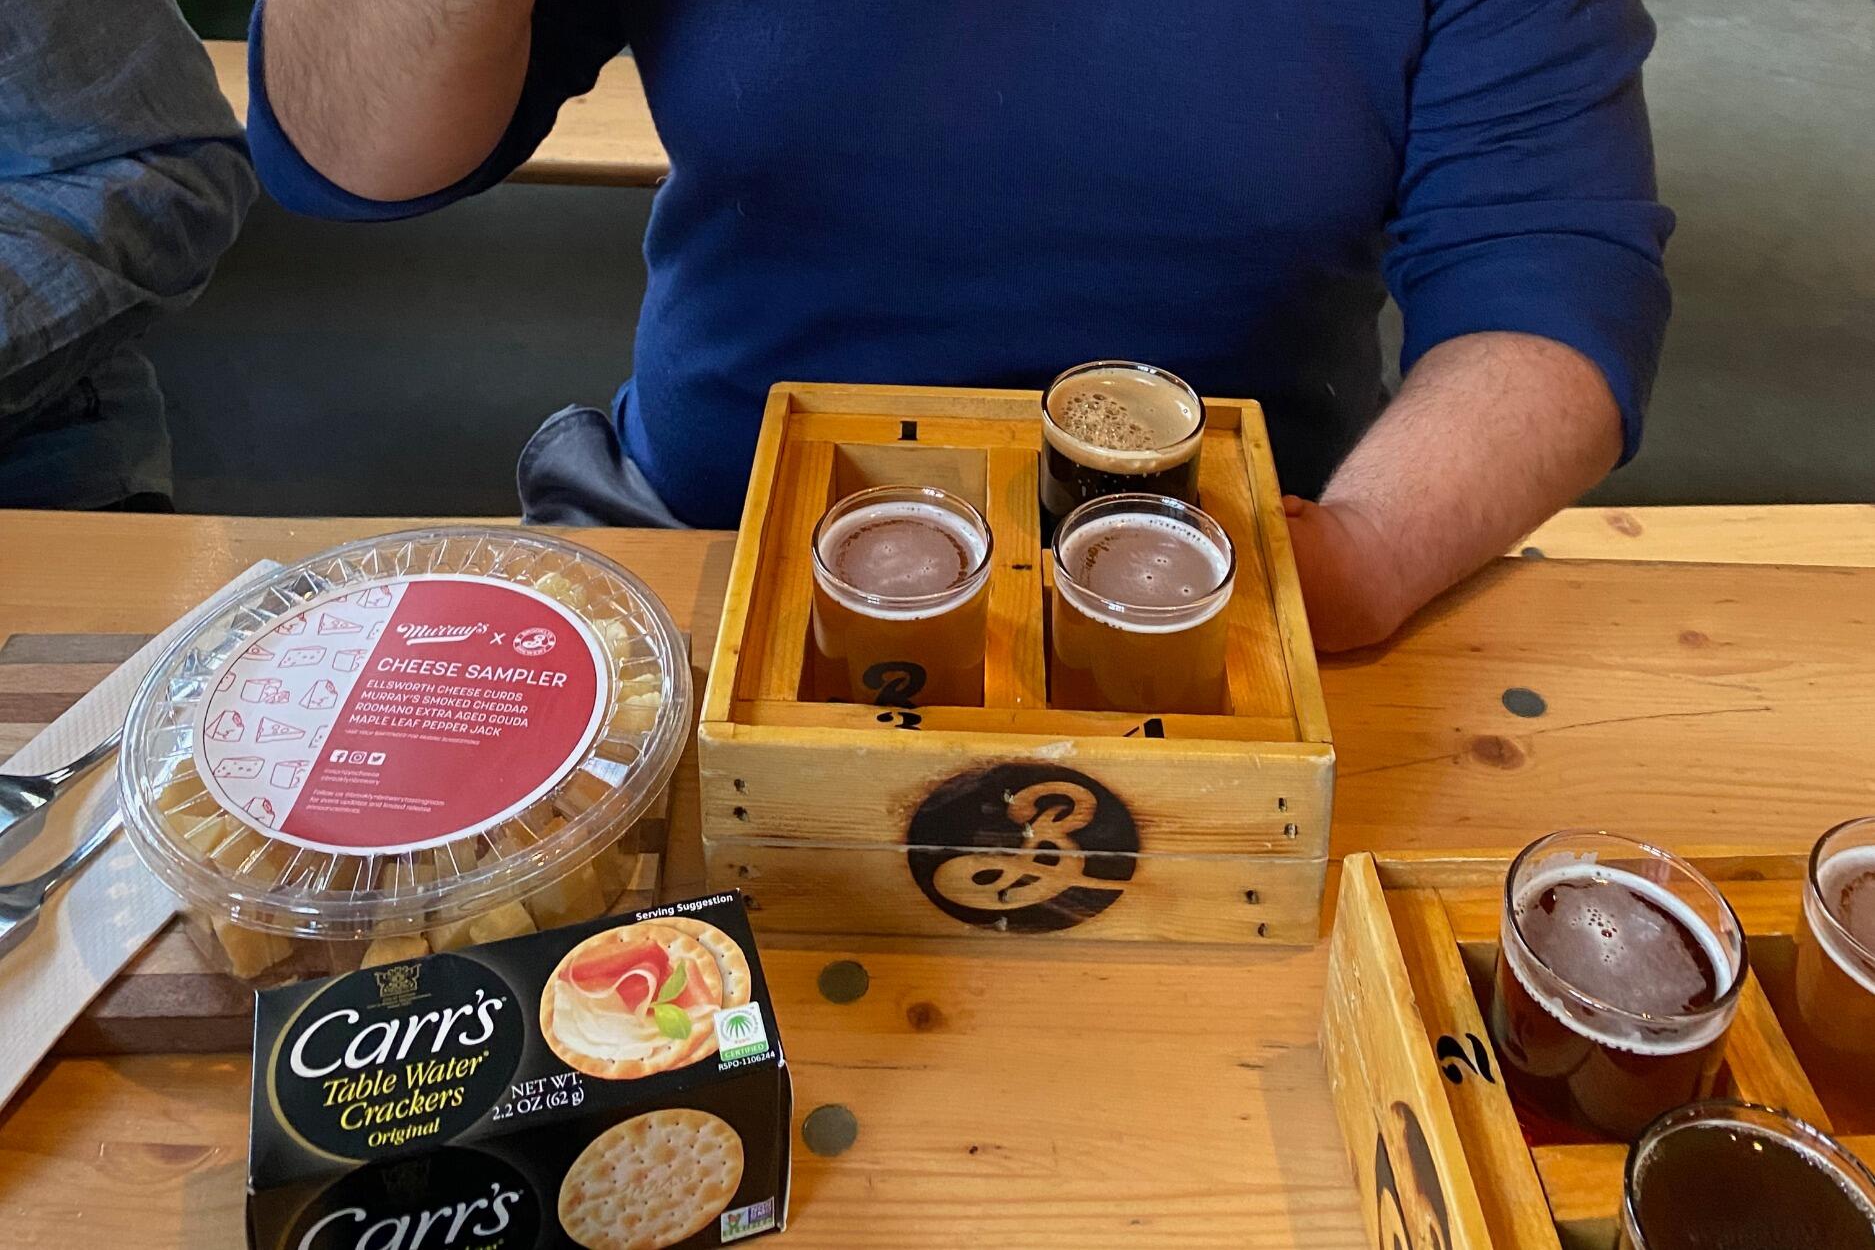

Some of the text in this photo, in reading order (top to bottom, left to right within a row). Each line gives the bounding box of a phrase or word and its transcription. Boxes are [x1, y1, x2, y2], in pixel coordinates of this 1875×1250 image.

[397, 622, 489, 645] Murray's
[377, 657, 568, 688] CHEESE SAMPLER
[360, 691, 529, 715] MURRAY'S SMOKED CHEDDAR
[366, 679, 523, 702] ELLSWORTH CHEESE CURDS
[349, 714, 502, 737] MAPLE LEAF PEPPER JACK
[354, 702, 529, 728] ROOMANO EXTRA AGED GOUDA
[635, 893, 733, 921] Serving Suggestion
[290, 988, 503, 1078] Carr's
[322, 1053, 484, 1107] Table Water
[511, 1071, 583, 1100] NET WT.
[340, 1086, 465, 1131] Crackers
[491, 1087, 585, 1121] 2.2 OZ (62 g)
[368, 1117, 440, 1148] Original
[298, 1182, 520, 1250] Carr's
